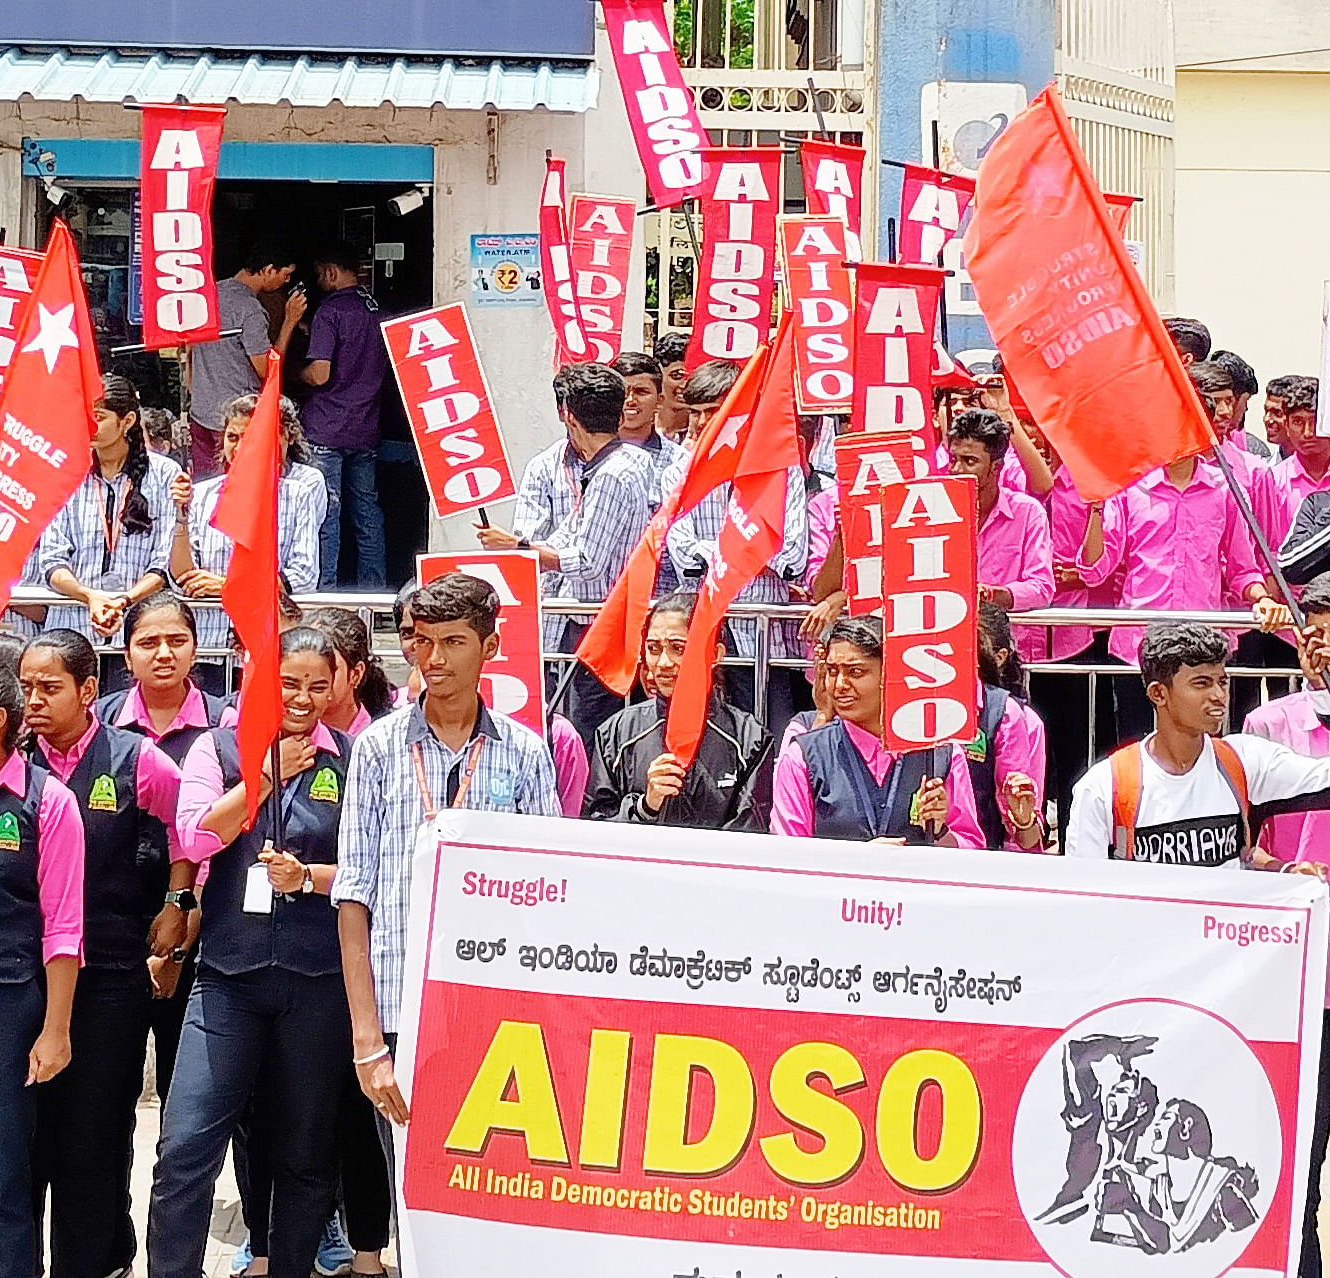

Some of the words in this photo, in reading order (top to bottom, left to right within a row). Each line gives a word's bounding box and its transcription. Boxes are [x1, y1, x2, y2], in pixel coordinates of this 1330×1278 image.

[623, 20, 703, 189] AIDSO
[150, 129, 209, 332] AIDSO
[497, 269, 518, 285] ₹2
[702, 162, 770, 359] AIDSO
[790, 226, 854, 400] AIDSO
[3, 411, 68, 469] RUGGLE
[406, 317, 502, 504] AIDSO
[864, 287, 931, 478] AID
[886, 481, 968, 743] AIDSO
[455, 936, 507, 963] ಆಲ್
[518, 942, 618, 974] ಇಂಡಿಯಾ
[461, 871, 569, 906] Struggle!
[840, 897, 905, 929] Unity!
[1201, 914, 1301, 947] Progress!
[443, 1019, 982, 1191] AIDSO
[448, 1164, 481, 1192] All
[485, 1168, 545, 1201] India
[550, 1181, 683, 1214] Democratic
[800, 1196, 942, 1232] Organisation
